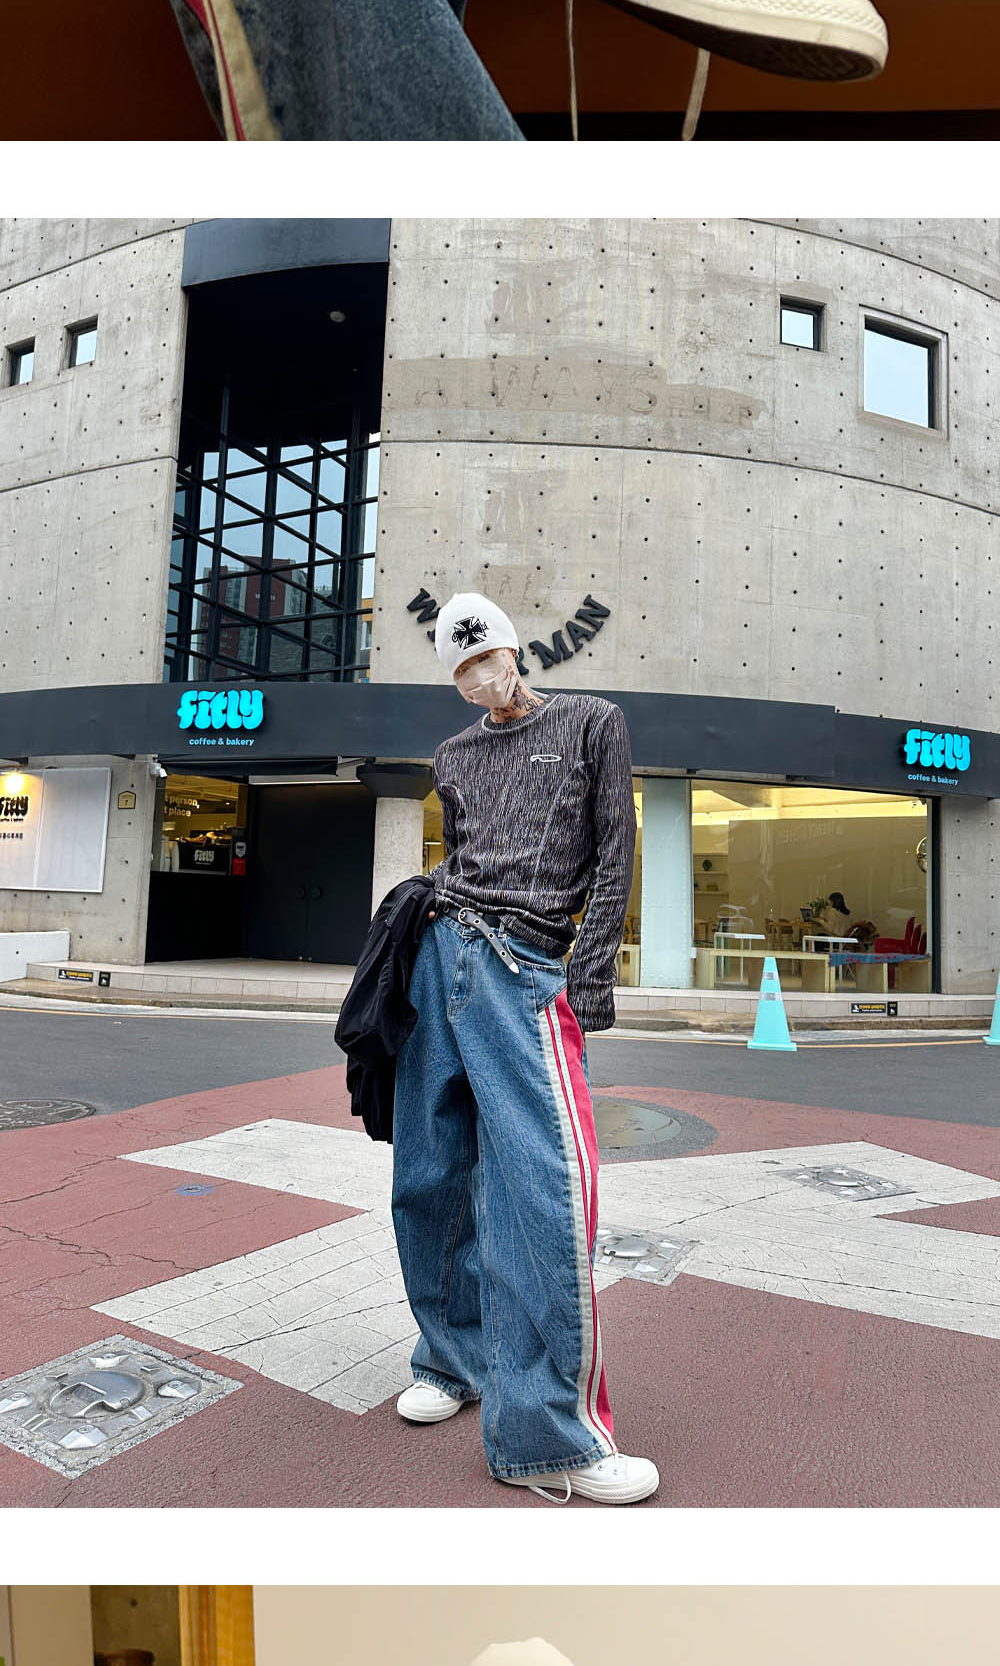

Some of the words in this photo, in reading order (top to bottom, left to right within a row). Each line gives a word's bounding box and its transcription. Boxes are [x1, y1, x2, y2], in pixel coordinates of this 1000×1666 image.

[528, 594, 611, 670] MAN
[189, 738, 216, 746] coffee
[217, 738, 224, 746] &
[226, 738, 255, 747] bakery
[907, 774, 930, 782] coffee
[931, 775, 937, 783] &
[937, 776, 959, 786] bakery
[168, 806, 192, 817] place
